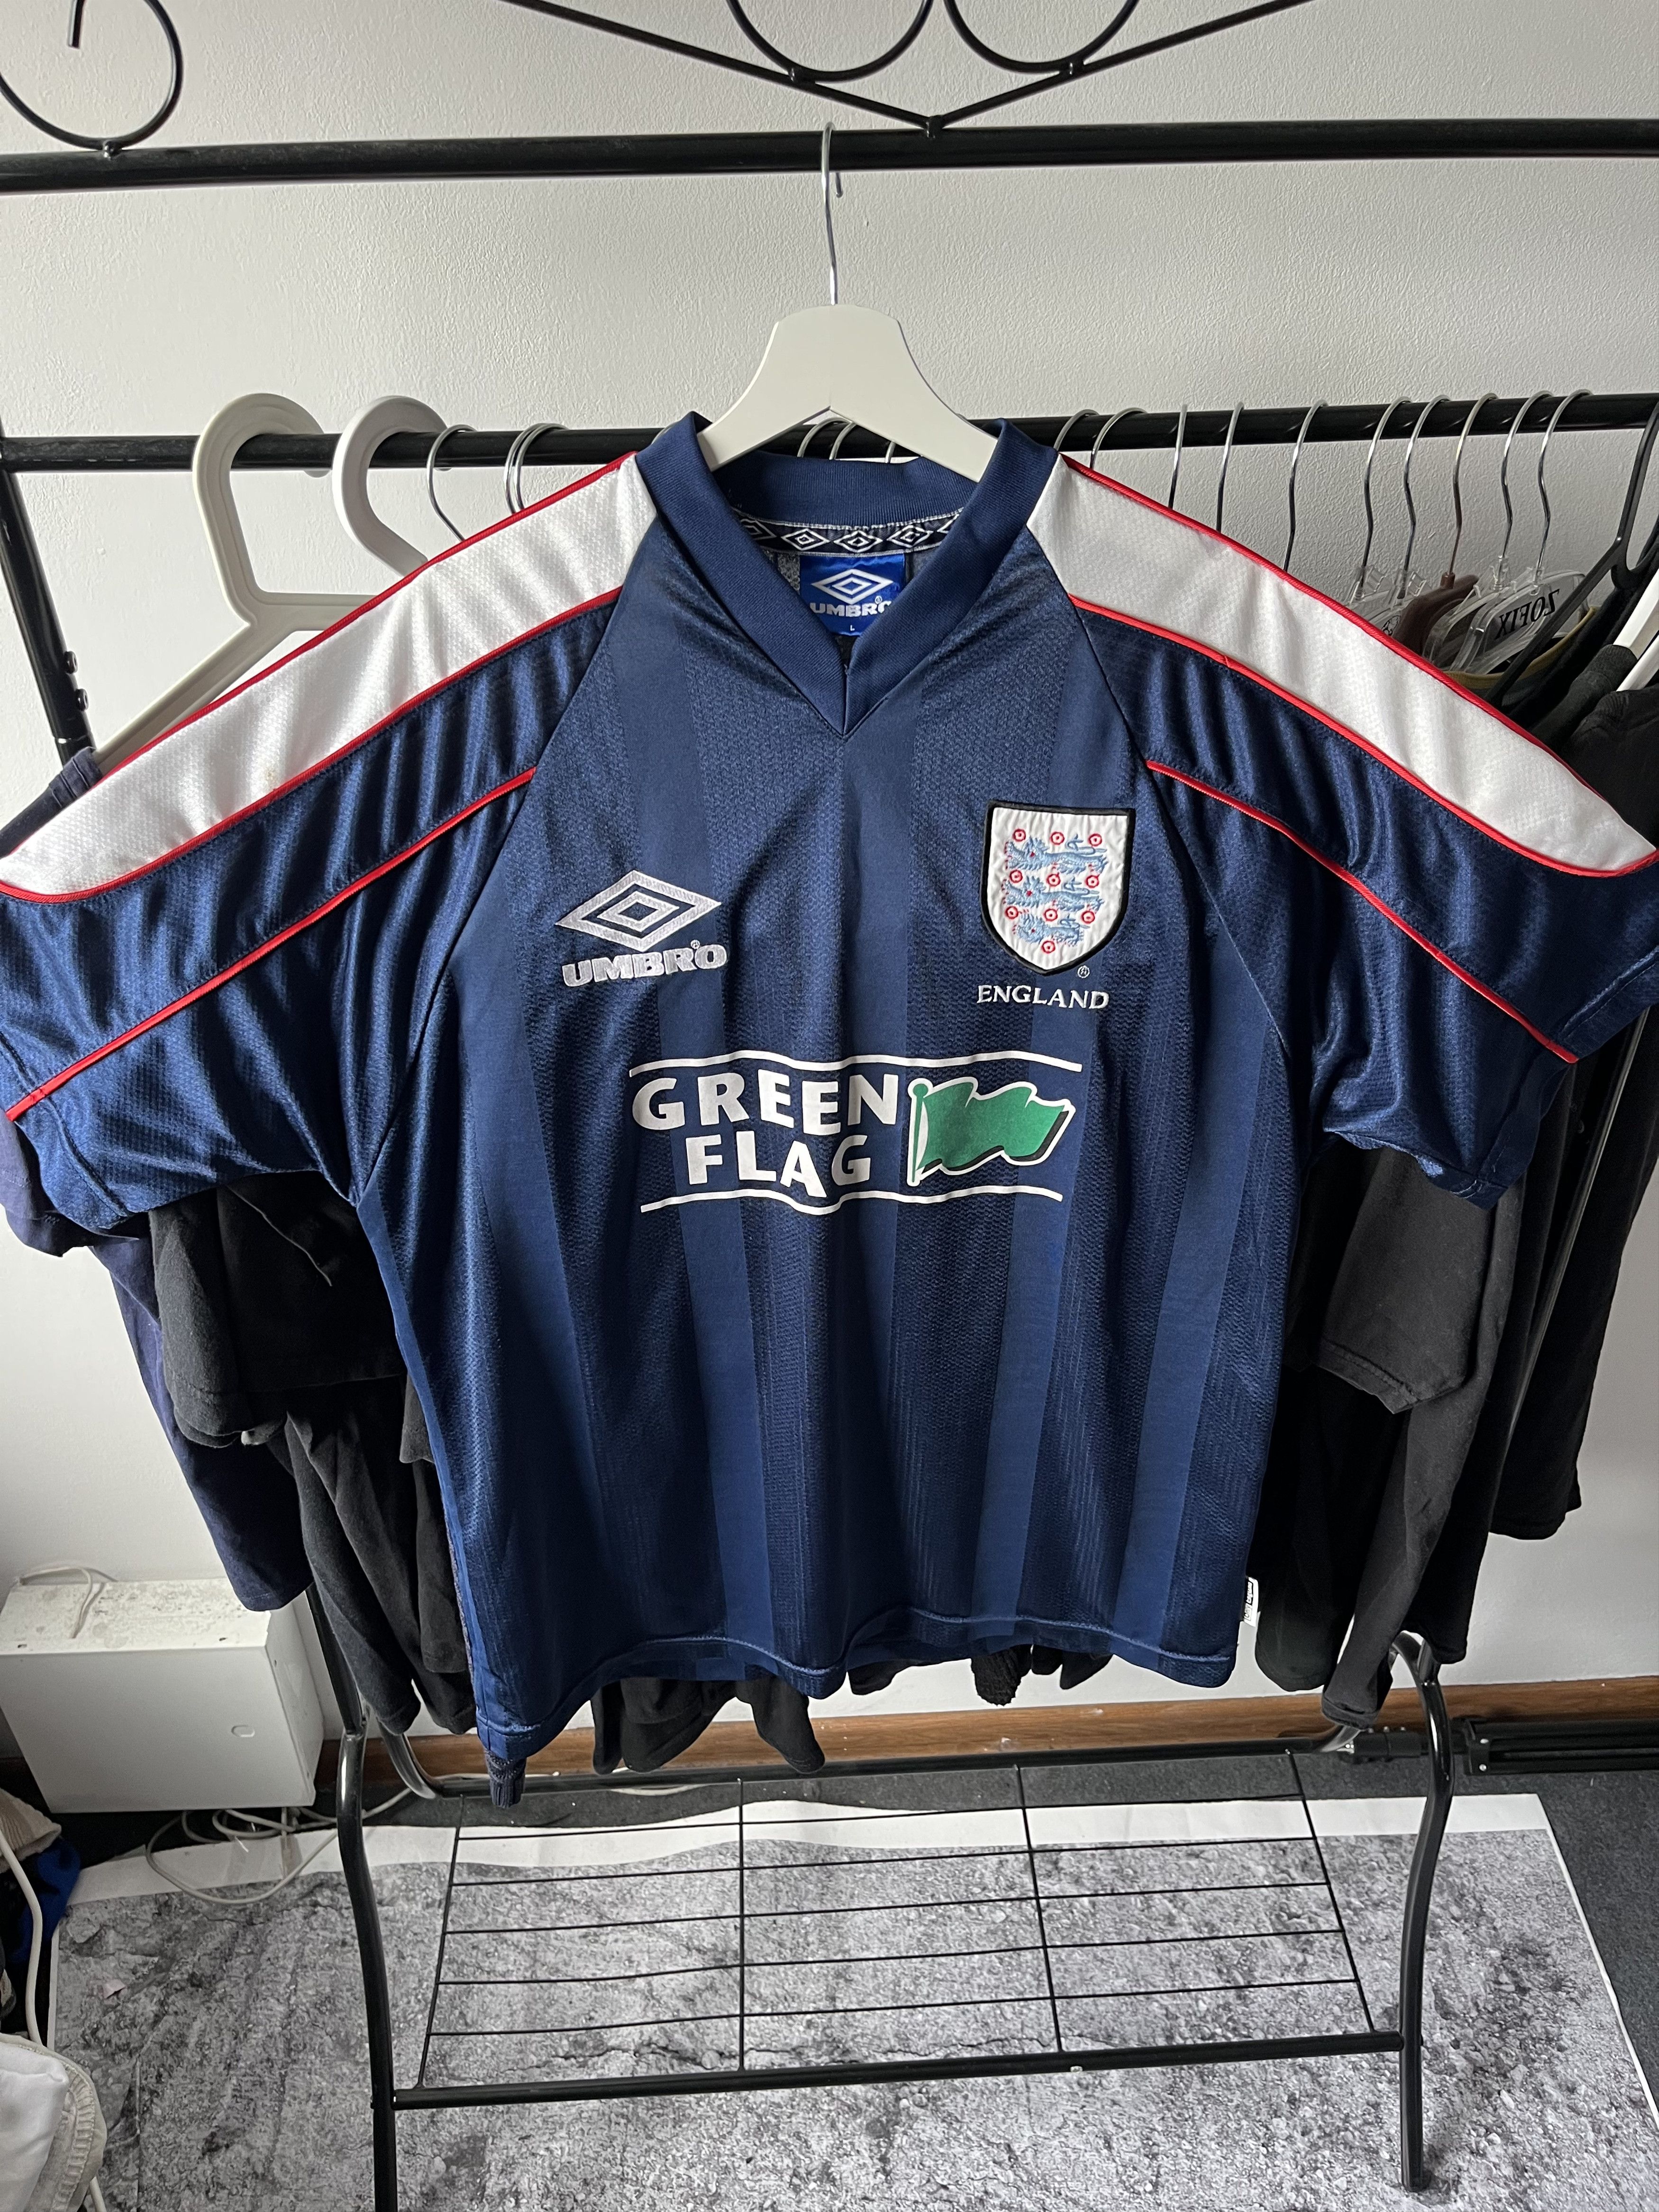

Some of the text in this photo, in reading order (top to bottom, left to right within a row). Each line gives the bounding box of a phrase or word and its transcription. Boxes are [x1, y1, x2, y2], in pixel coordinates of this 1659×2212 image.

[562, 944, 728, 987] UMBRO
[976, 984, 1110, 1009] ENGLAND
[632, 1068, 899, 1136] GREEN
[685, 1130, 871, 1199] FLAG
